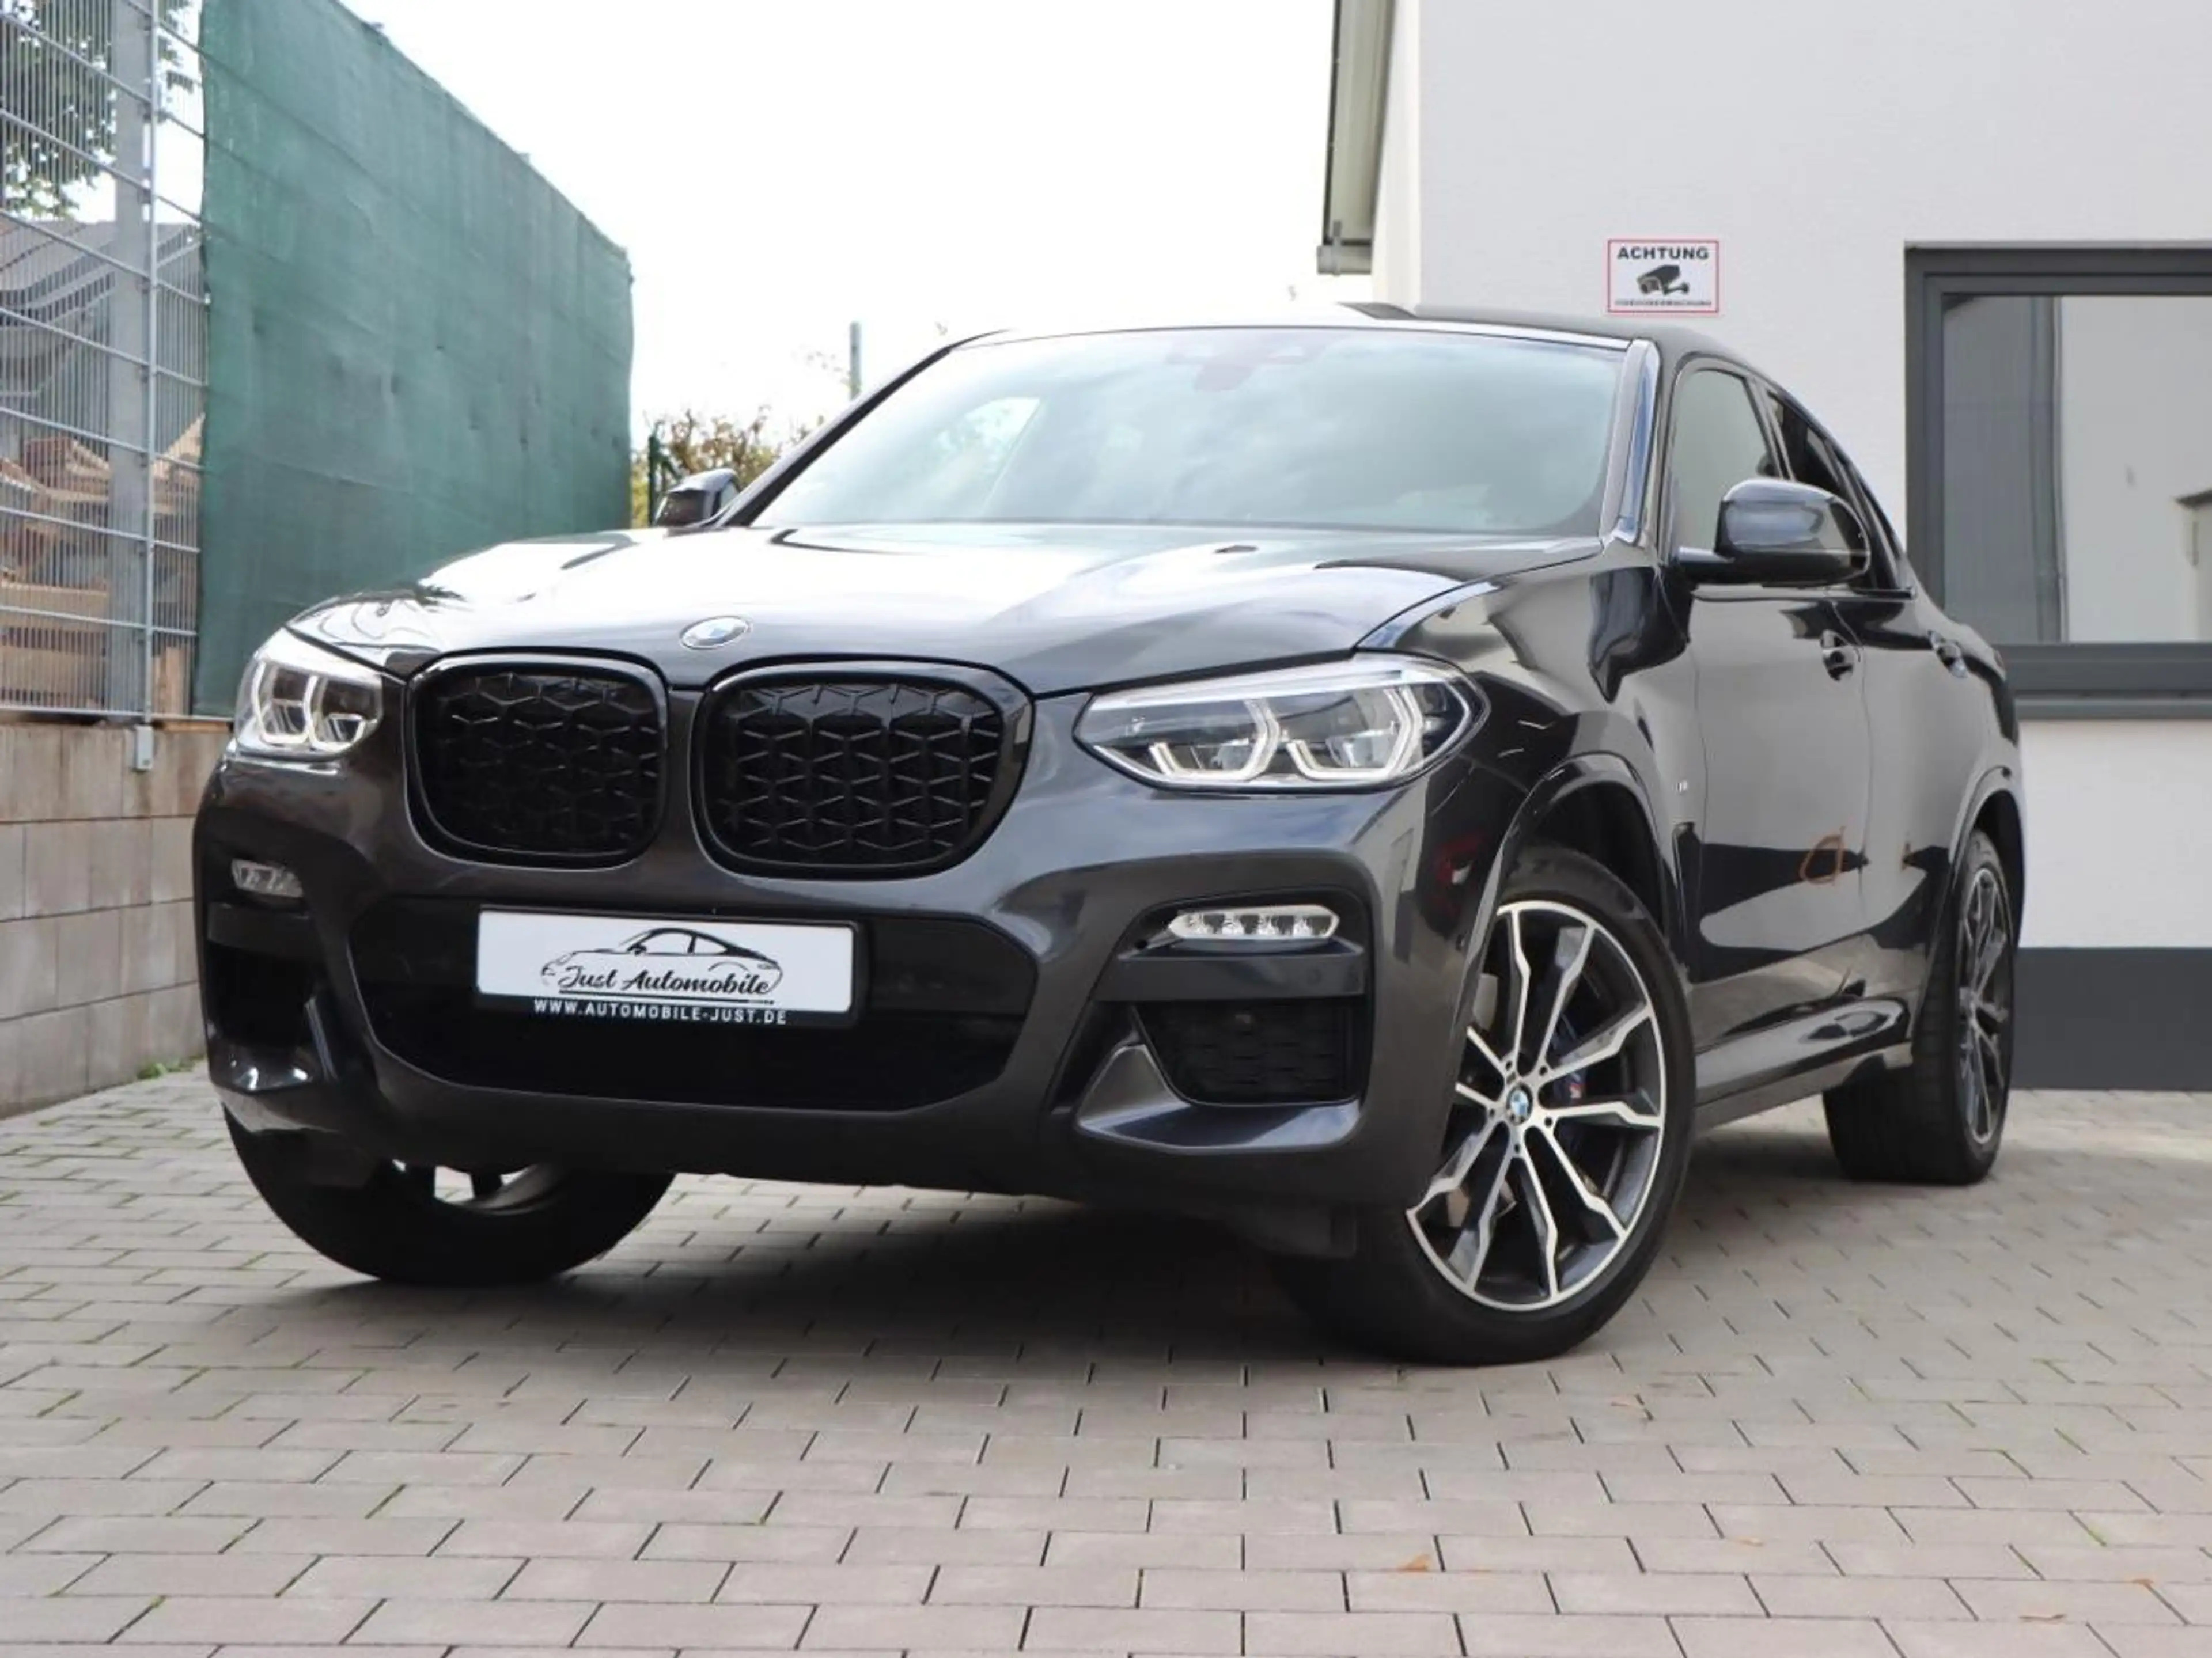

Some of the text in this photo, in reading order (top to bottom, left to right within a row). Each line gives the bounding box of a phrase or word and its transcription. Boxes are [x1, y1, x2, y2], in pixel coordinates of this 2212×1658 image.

[1617, 246, 1709, 260] ACHTUNG
[558, 965, 771, 995] Just Automobile
[533, 998, 786, 1025] WWW.AUTOMOBILE-JUST.DE
